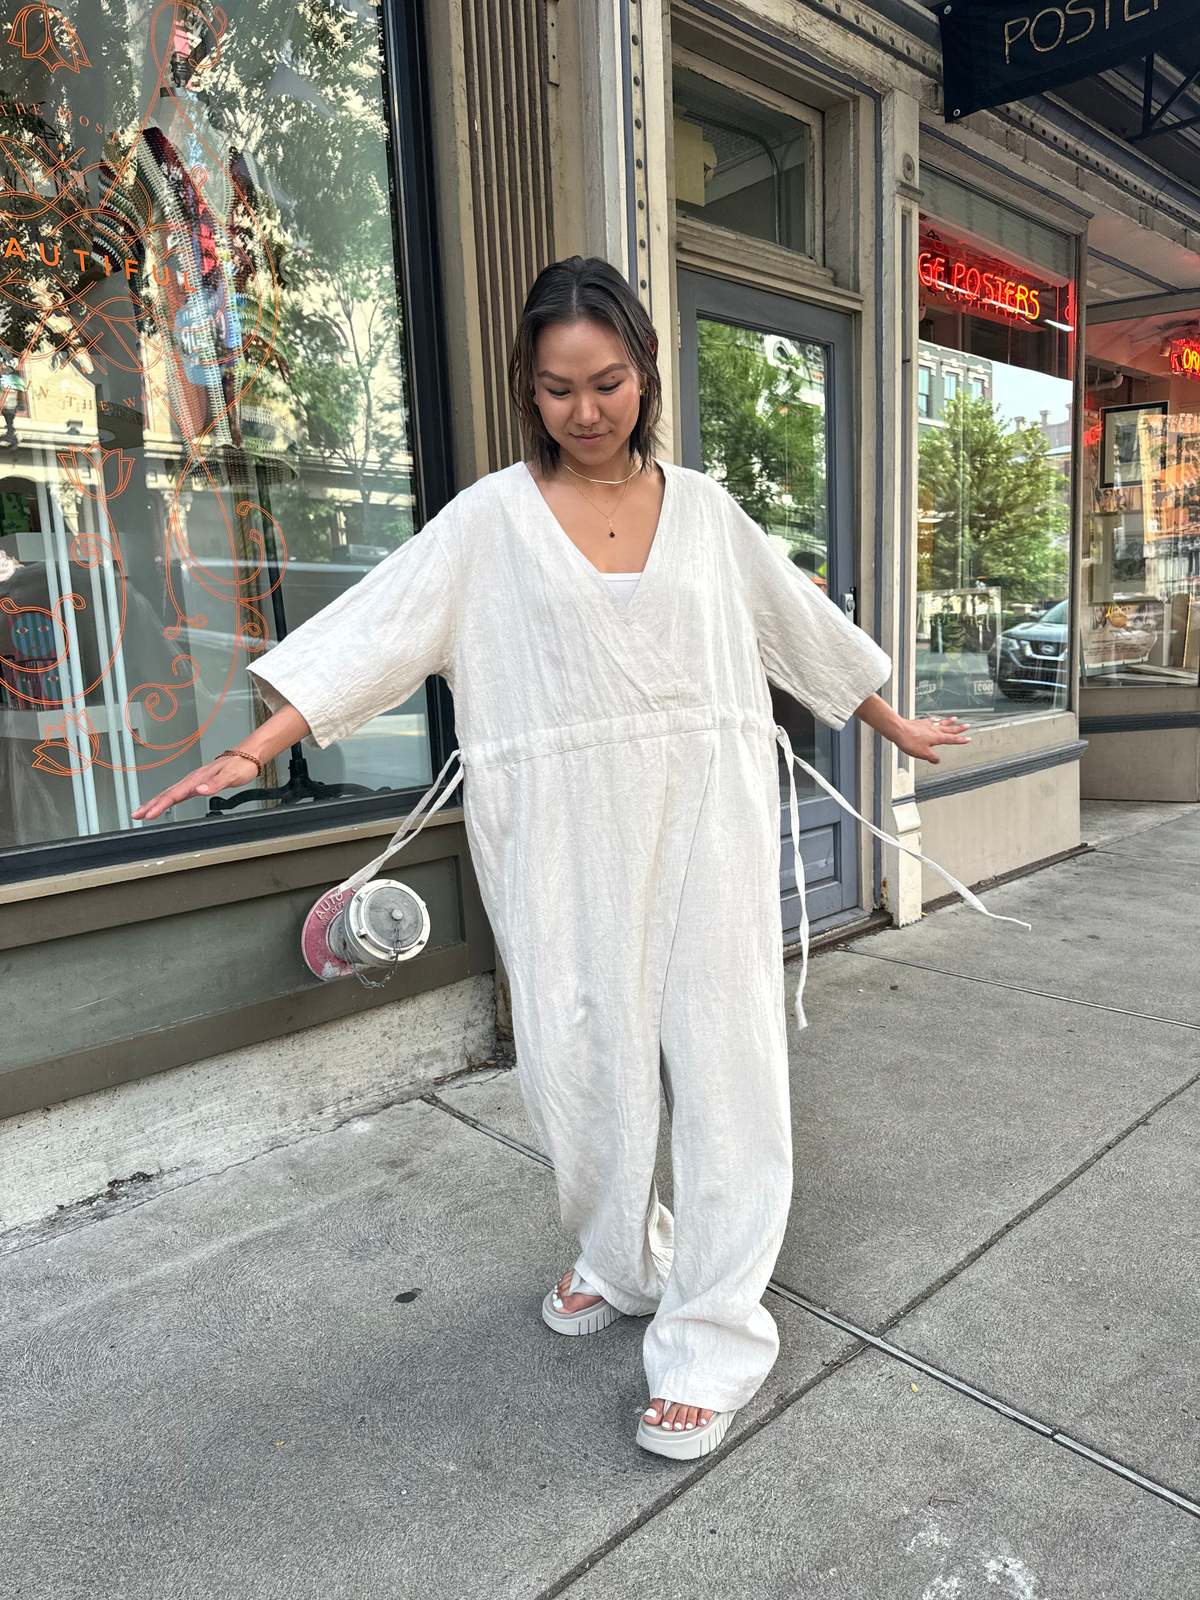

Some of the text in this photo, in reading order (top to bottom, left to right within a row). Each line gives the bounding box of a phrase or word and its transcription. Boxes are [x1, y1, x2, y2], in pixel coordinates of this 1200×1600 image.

[1004, 0, 1159, 64] POSTE
[0, 102, 44, 117] THE
[3, 236, 197, 293] AUTIFUL
[918, 253, 1040, 320] GE POSTERS
